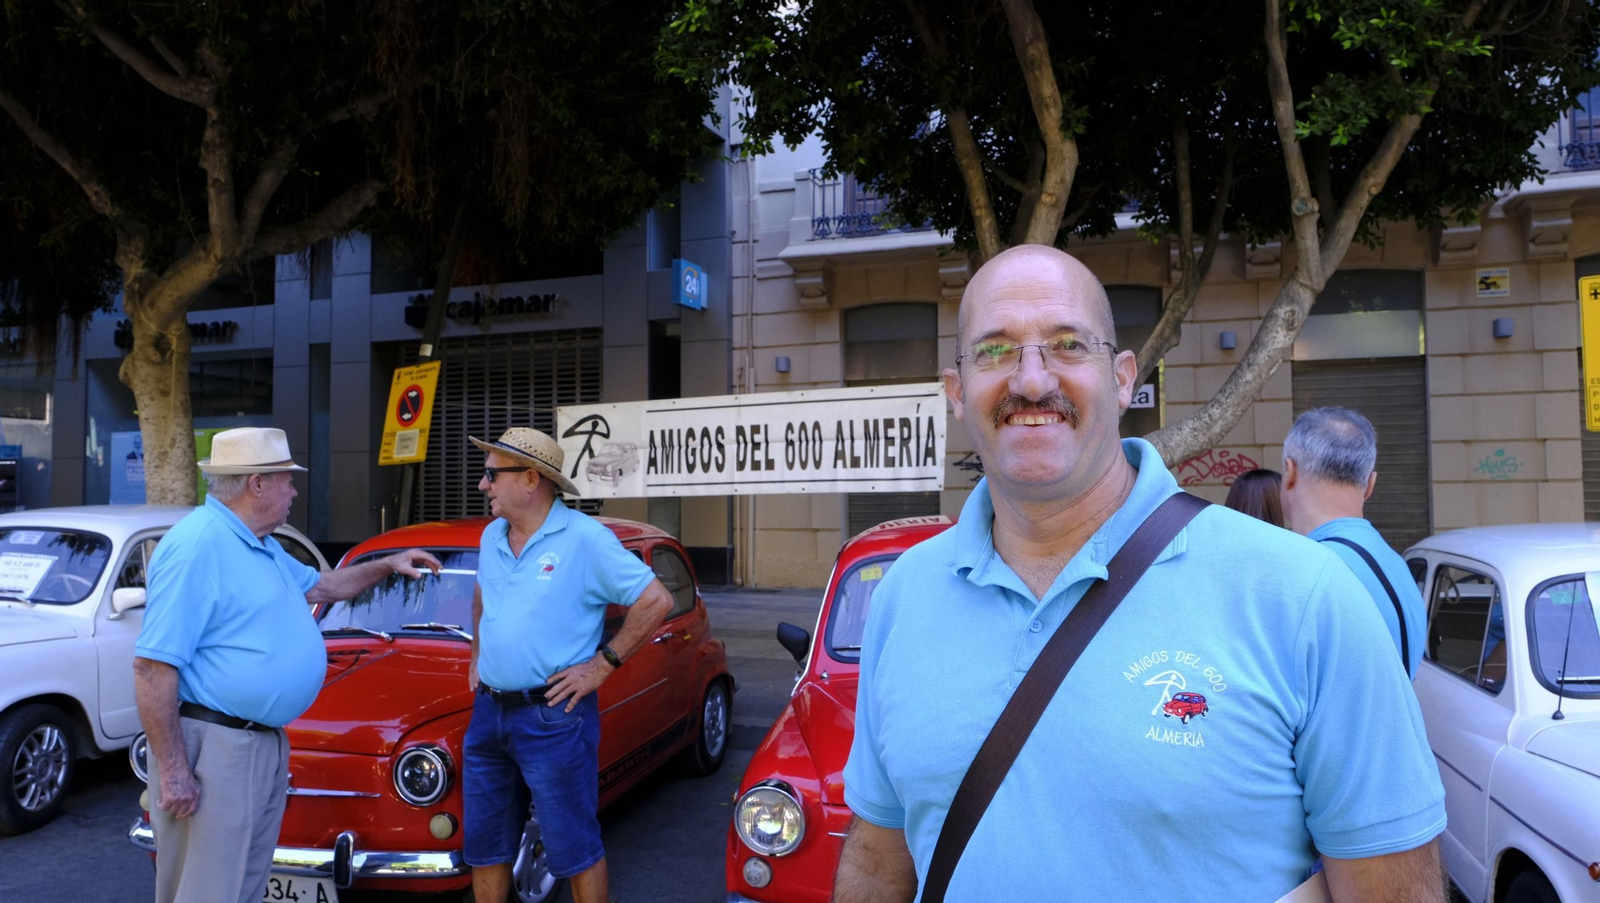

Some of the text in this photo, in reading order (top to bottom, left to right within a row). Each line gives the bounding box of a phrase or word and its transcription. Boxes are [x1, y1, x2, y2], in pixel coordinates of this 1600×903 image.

[646, 425, 726, 475] AMIGOS
[735, 423, 775, 472] DEL
[785, 420, 823, 471] 600
[833, 403, 937, 469] ALMERÍA
[1122, 650, 1227, 692] AMIGOS DEL 600
[1144, 726, 1205, 748] ALMERIA
